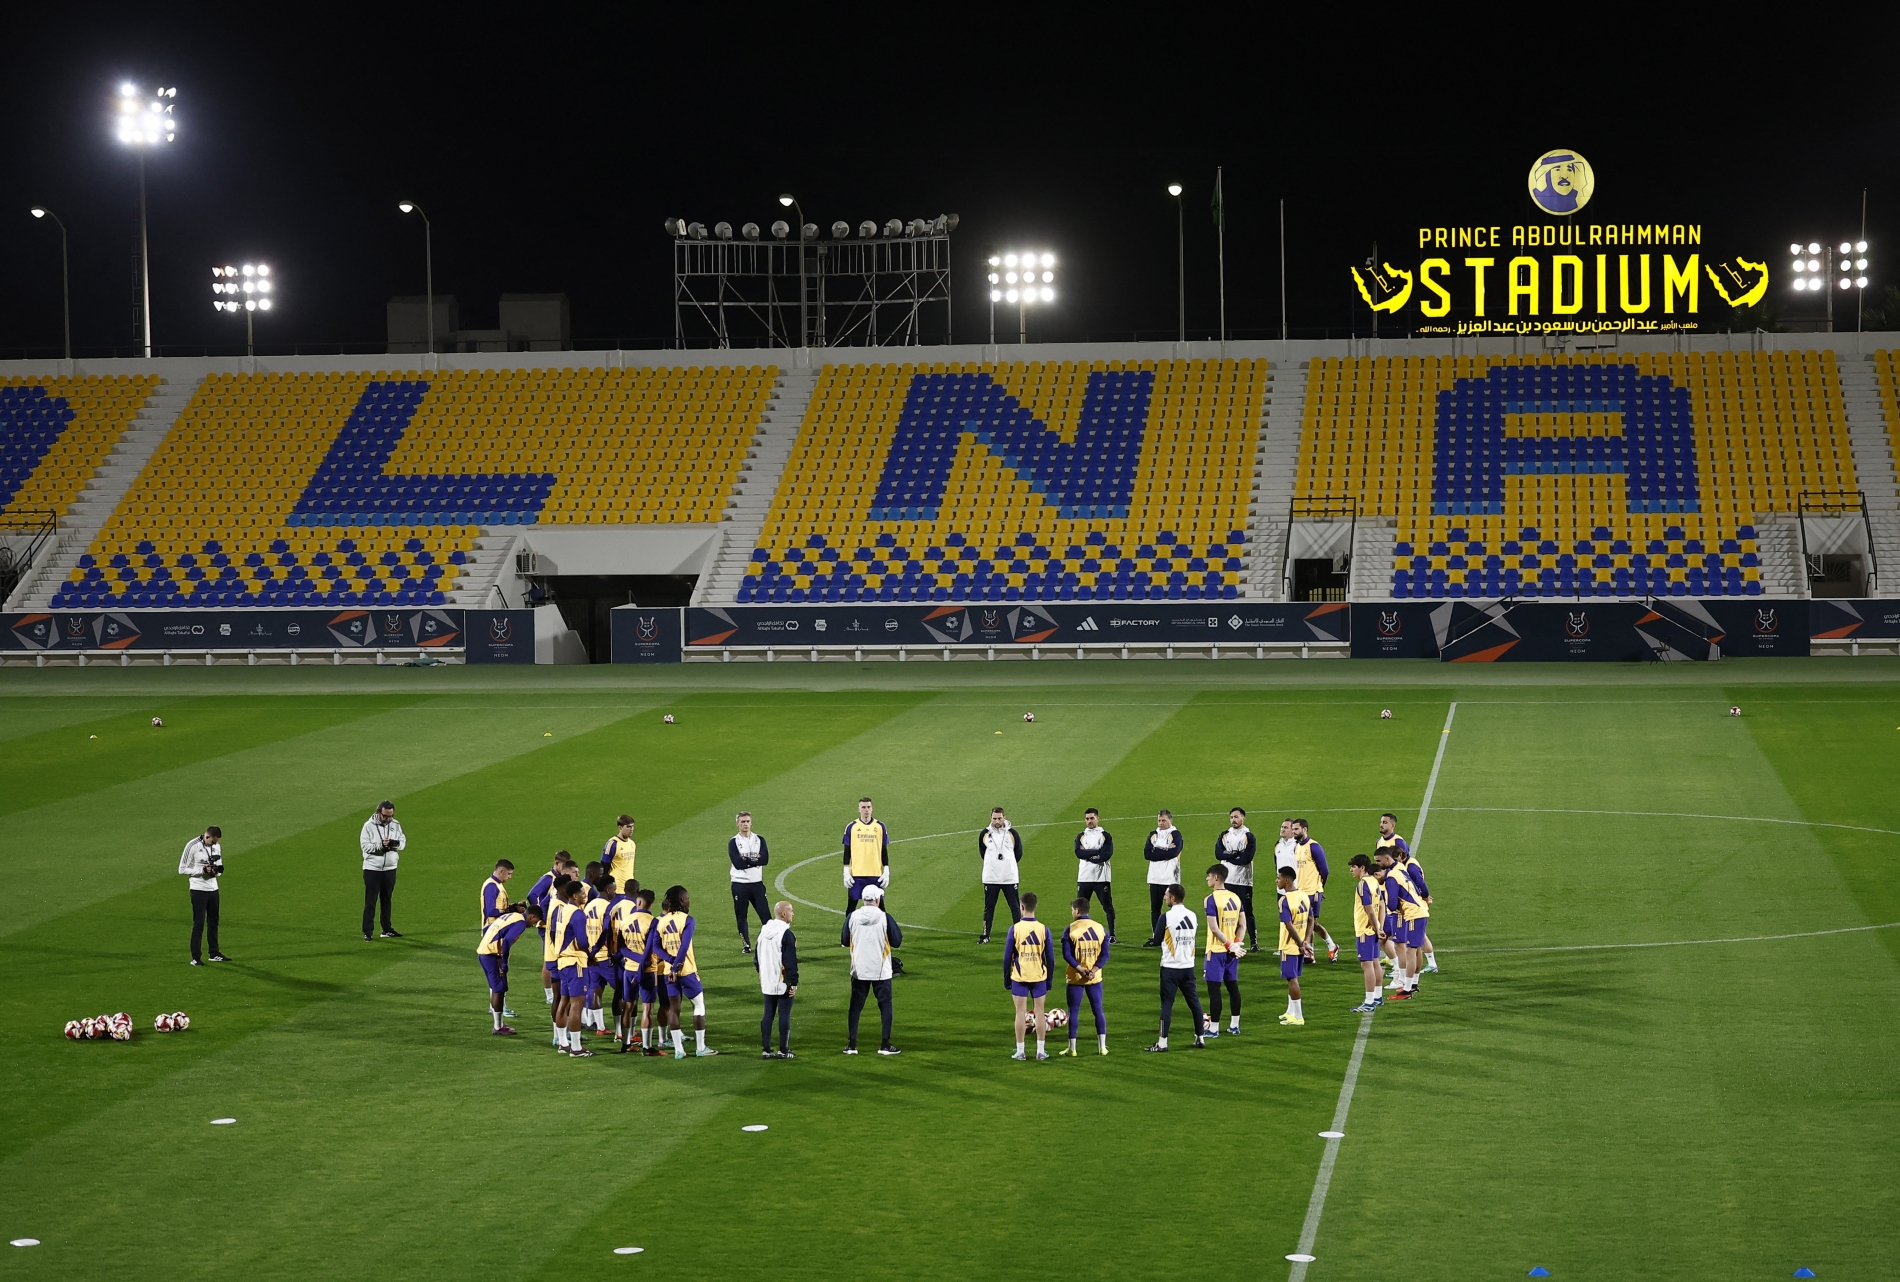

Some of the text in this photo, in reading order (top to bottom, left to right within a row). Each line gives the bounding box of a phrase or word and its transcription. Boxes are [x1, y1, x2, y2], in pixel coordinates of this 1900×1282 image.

[1419, 224, 1701, 249] PRINCE ABDULRAHMMAN
[1419, 253, 1700, 318] STADIUM
[1457, 320, 1492, 335] العزيز
[1493, 322, 1516, 333] عبد
[1516, 320, 1532, 334] بن
[1534, 321, 1575, 334] سعود
[1575, 320, 1592, 333] بن
[1591, 317, 1635, 333] الرحمن
[1636, 320, 1659, 333] عبد
[1660, 320, 1678, 331] الأمير
[1679, 321, 1699, 330] ملعب
